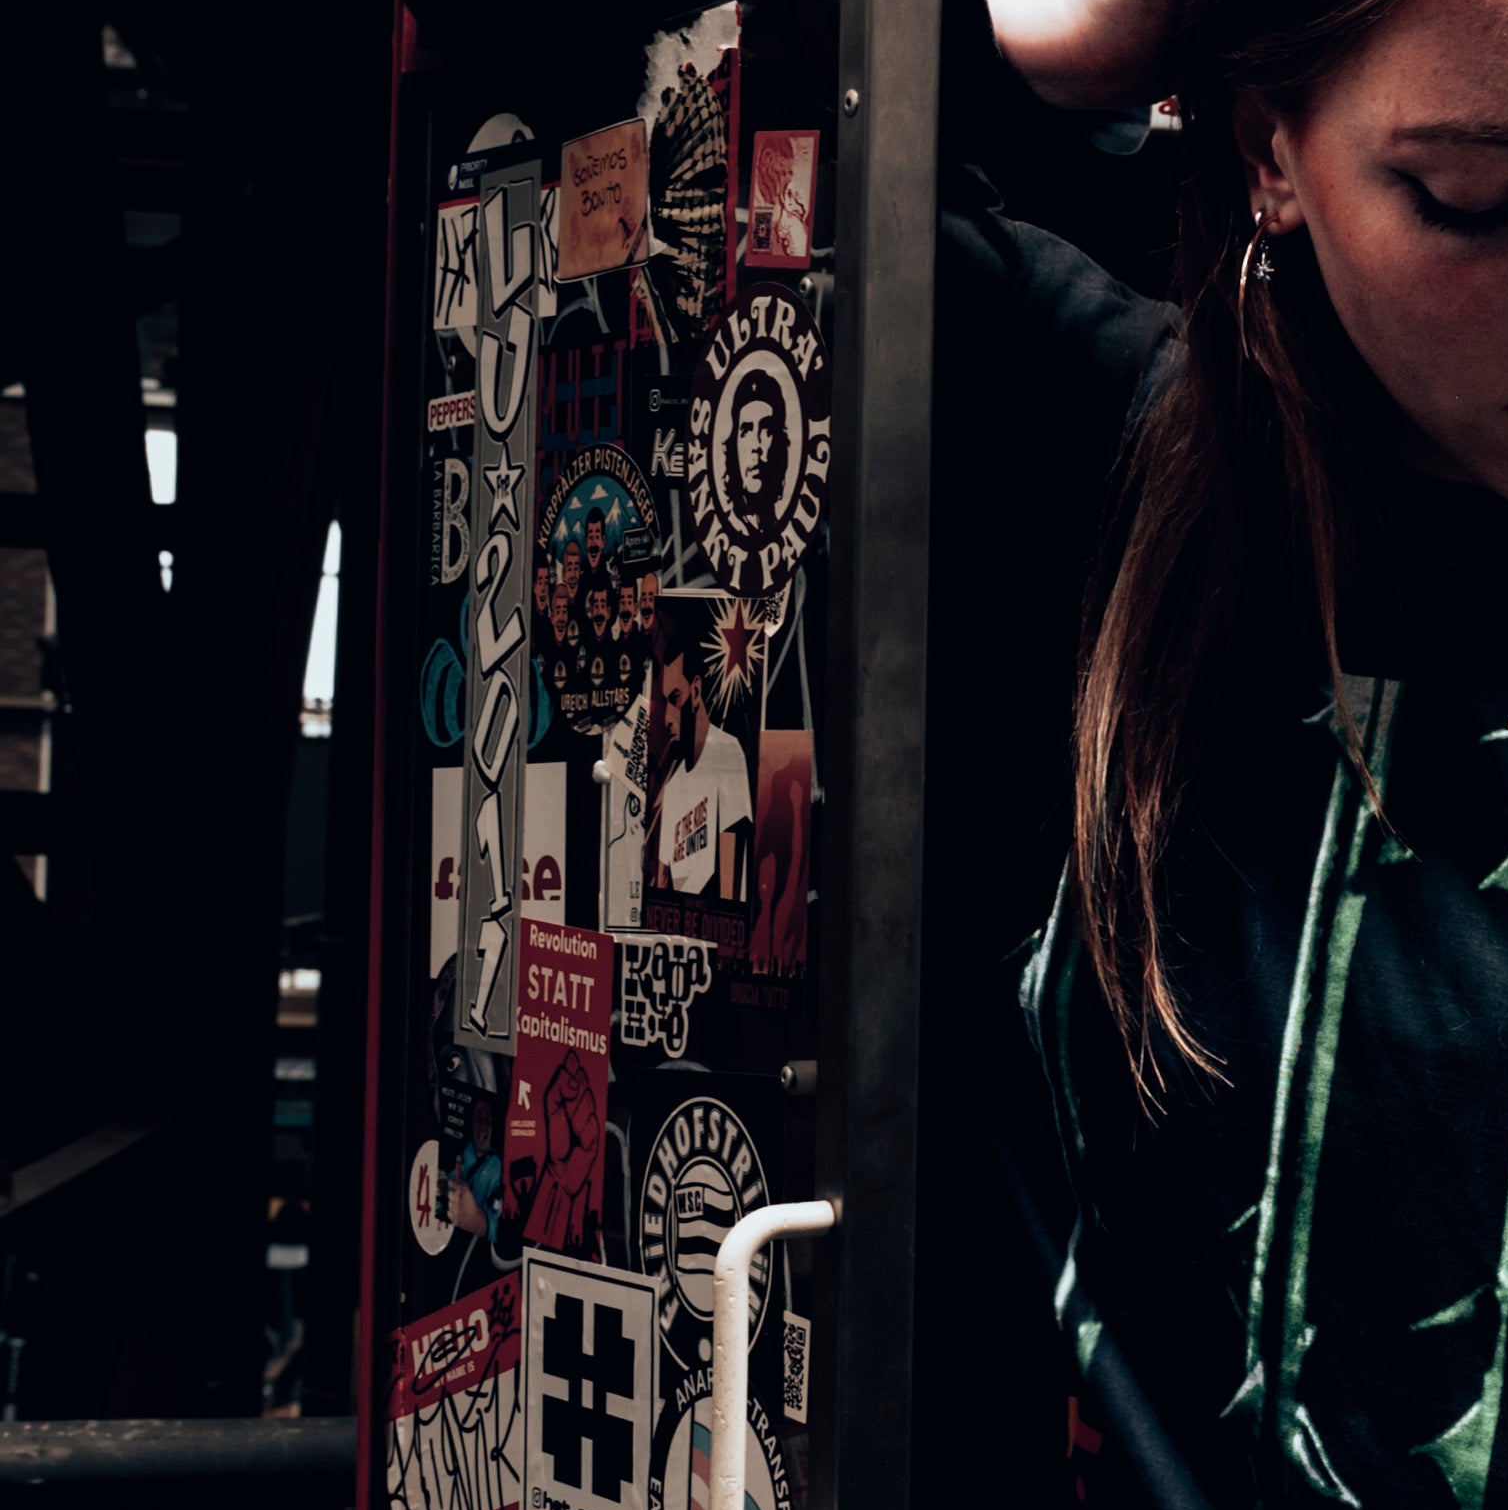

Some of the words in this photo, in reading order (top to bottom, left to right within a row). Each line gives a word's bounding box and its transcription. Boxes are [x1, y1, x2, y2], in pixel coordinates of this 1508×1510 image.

[430, 396, 476, 428] PEPPERS
[688, 396, 749, 590] SANKT
[758, 415, 832, 590] PAULI
[529, 923, 598, 961] Revolution
[527, 963, 595, 1013] STATT
[412, 1308, 490, 1379] HELLO
